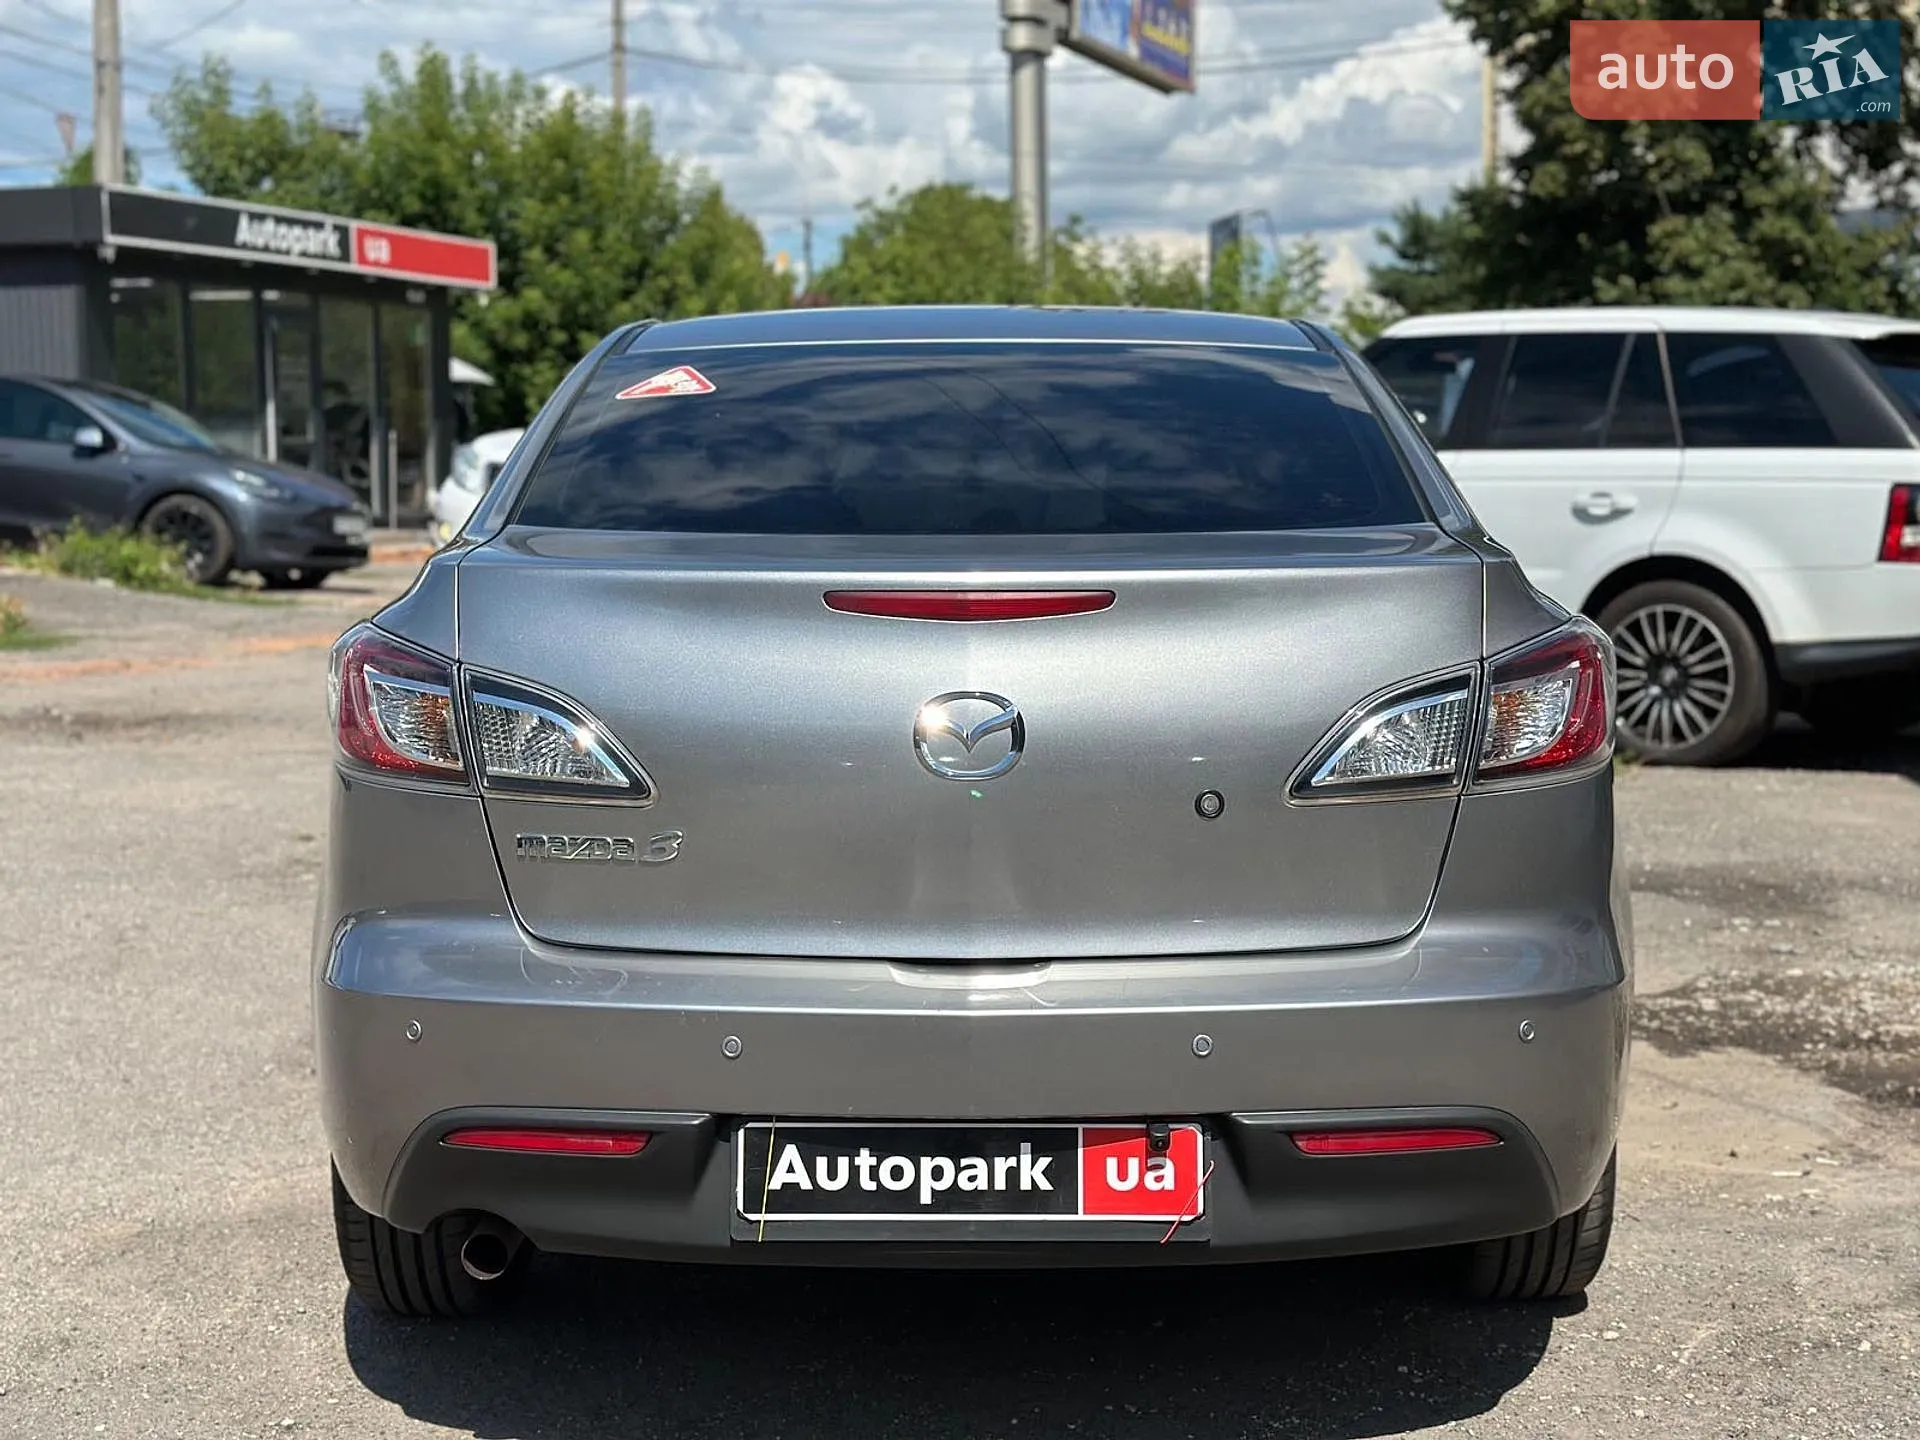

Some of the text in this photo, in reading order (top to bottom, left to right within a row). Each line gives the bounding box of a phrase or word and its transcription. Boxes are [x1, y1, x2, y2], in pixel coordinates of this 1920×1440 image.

[234, 211, 342, 260] Autopark
[639, 830, 683, 862] 3
[768, 1142, 1176, 1205] Autopark ua
